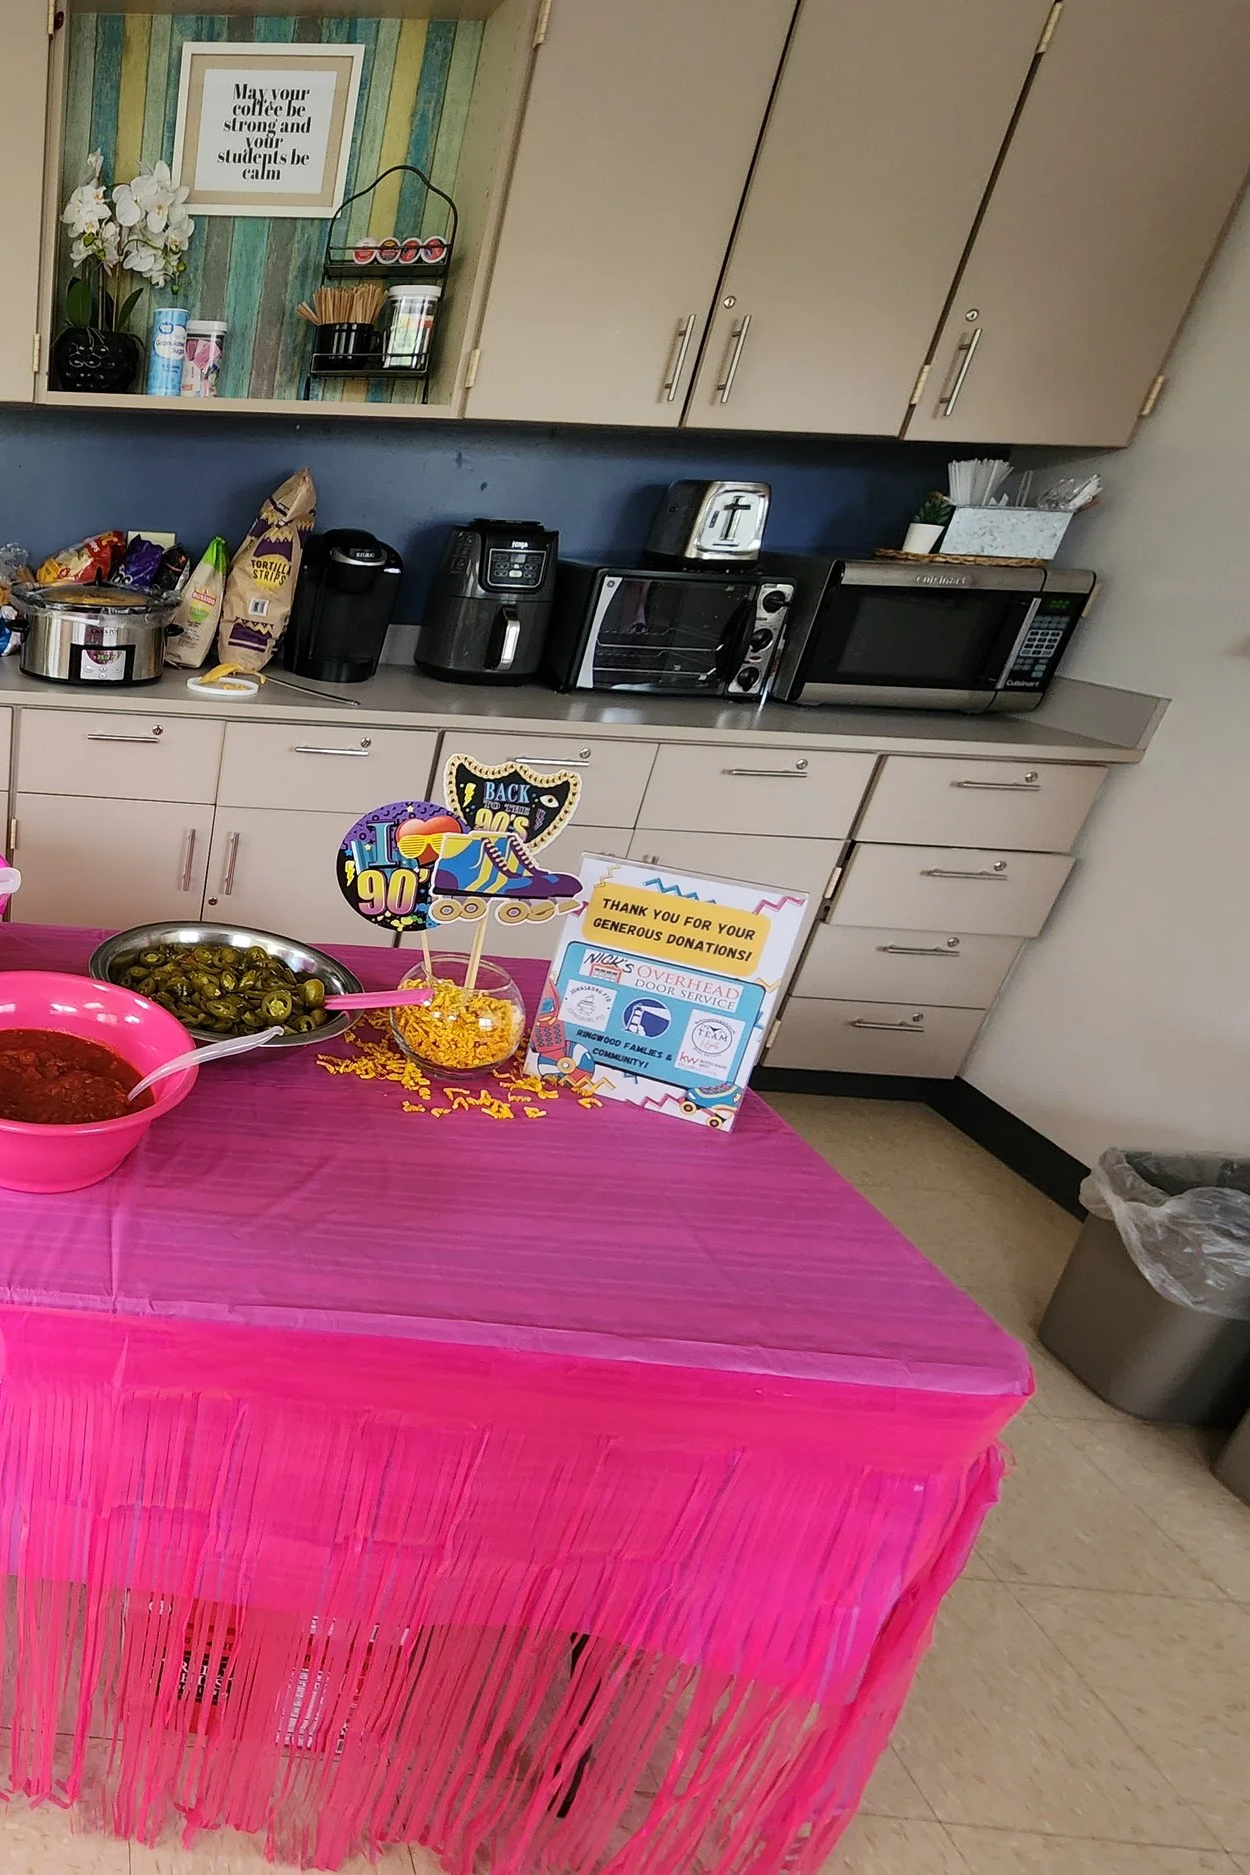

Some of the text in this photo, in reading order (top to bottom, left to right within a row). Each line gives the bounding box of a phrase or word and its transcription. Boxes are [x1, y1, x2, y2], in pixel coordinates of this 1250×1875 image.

[233, 83, 310, 104] May your
[232, 100, 306, 117] coffee be
[223, 117, 312, 138] strong and
[245, 135, 284, 151] your
[217, 148, 310, 166] students be
[242, 164, 281, 180] calm
[156, 339, 186, 347] Granulate
[253, 568, 287, 586] STRIPS
[484, 781, 531, 803] BACK
[483, 800, 531, 816] TO THE
[367, 821, 397, 868] I
[357, 868, 430, 916] 90'
[602, 898, 756, 941] THANK YOU FOR YOUR
[593, 917, 753, 962] GENEROUS DONATIONS!
[635, 978, 736, 1011] DOOR SERVICE
[576, 1029, 621, 1050] RINGWOOD
[698, 1028, 728, 1042] TEAM
[592, 1047, 649, 1069] COMMUNITY!
